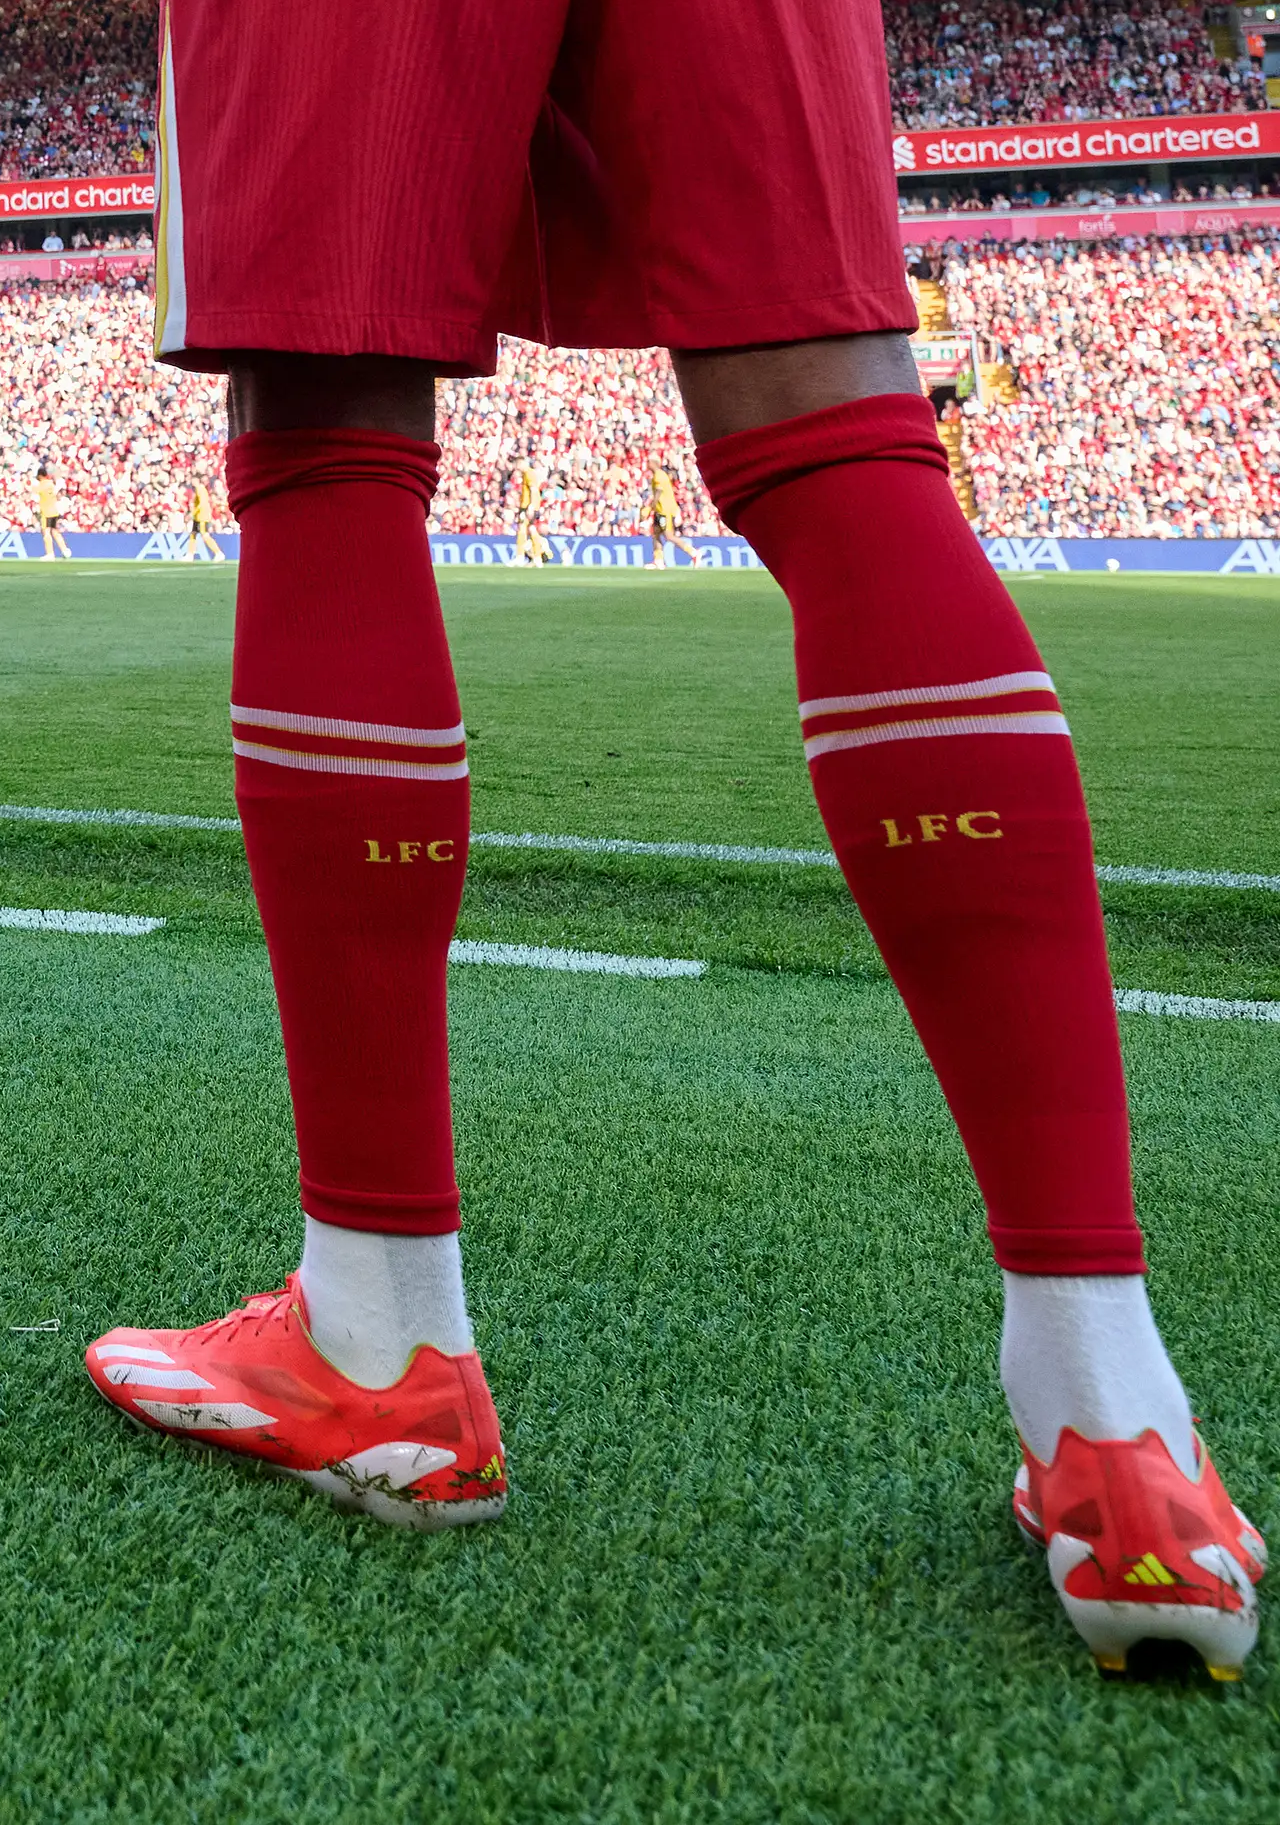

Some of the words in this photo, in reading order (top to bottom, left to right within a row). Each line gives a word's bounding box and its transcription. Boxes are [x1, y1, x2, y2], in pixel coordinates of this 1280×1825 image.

[925, 131, 1081, 165] standard
[1085, 122, 1260, 157] chartered
[74, 182, 154, 209] charte
[987, 537, 1071, 572] AXA
[1218, 539, 1280, 575] AX
[881, 810, 1004, 848] LFC
[364, 839, 455, 864] LFC
